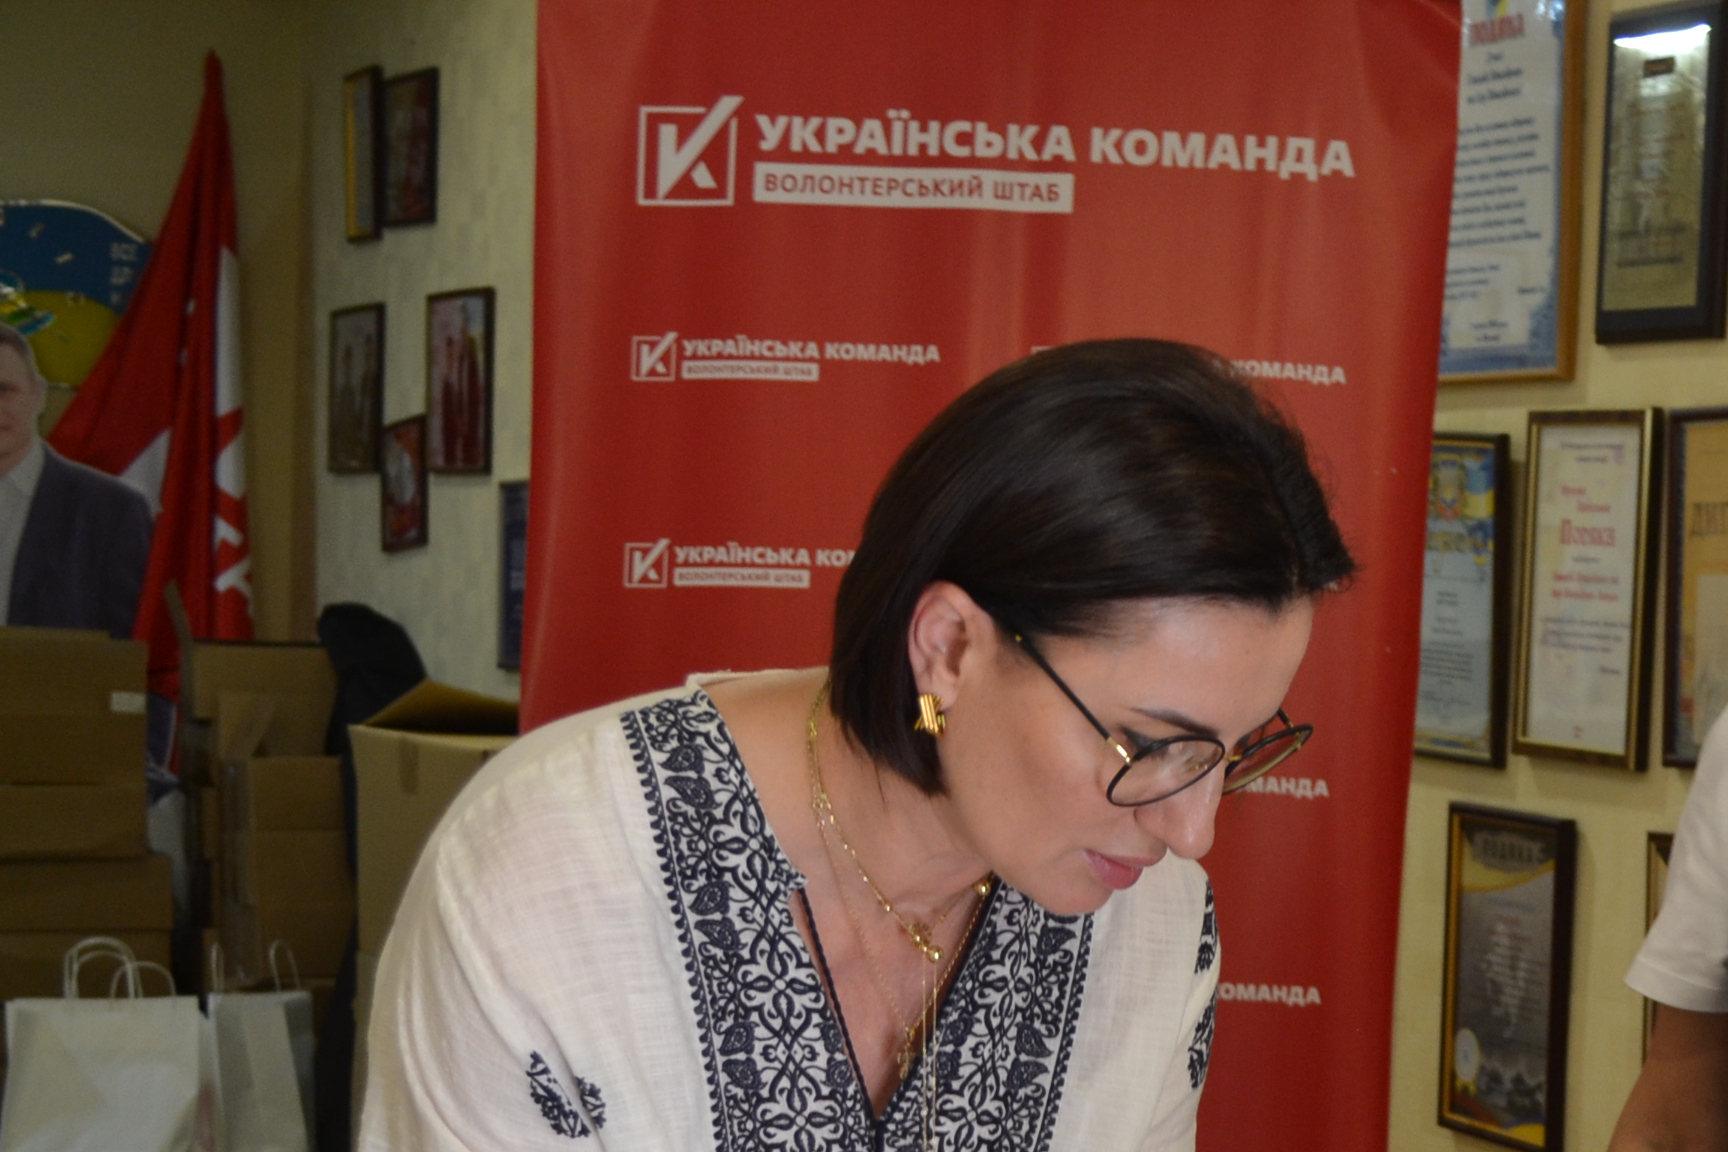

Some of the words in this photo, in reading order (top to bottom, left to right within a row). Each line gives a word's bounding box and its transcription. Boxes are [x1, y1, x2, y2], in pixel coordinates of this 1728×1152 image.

[755, 109, 1077, 163] УКРАЇНСЬКА
[1089, 126, 1356, 182] КОМАНДА
[763, 172, 984, 199] ВОЛОНТЕРСЬКИЙ
[993, 181, 1061, 203] ШТАБ
[682, 334, 821, 360] УКРАЇНСЬКА
[824, 342, 941, 367] КОМАНДА
[674, 541, 811, 566] УКРАЇНСЬКА
[1242, 775, 1330, 800] МАНДА
[1217, 982, 1322, 1007] ОМАНДА
